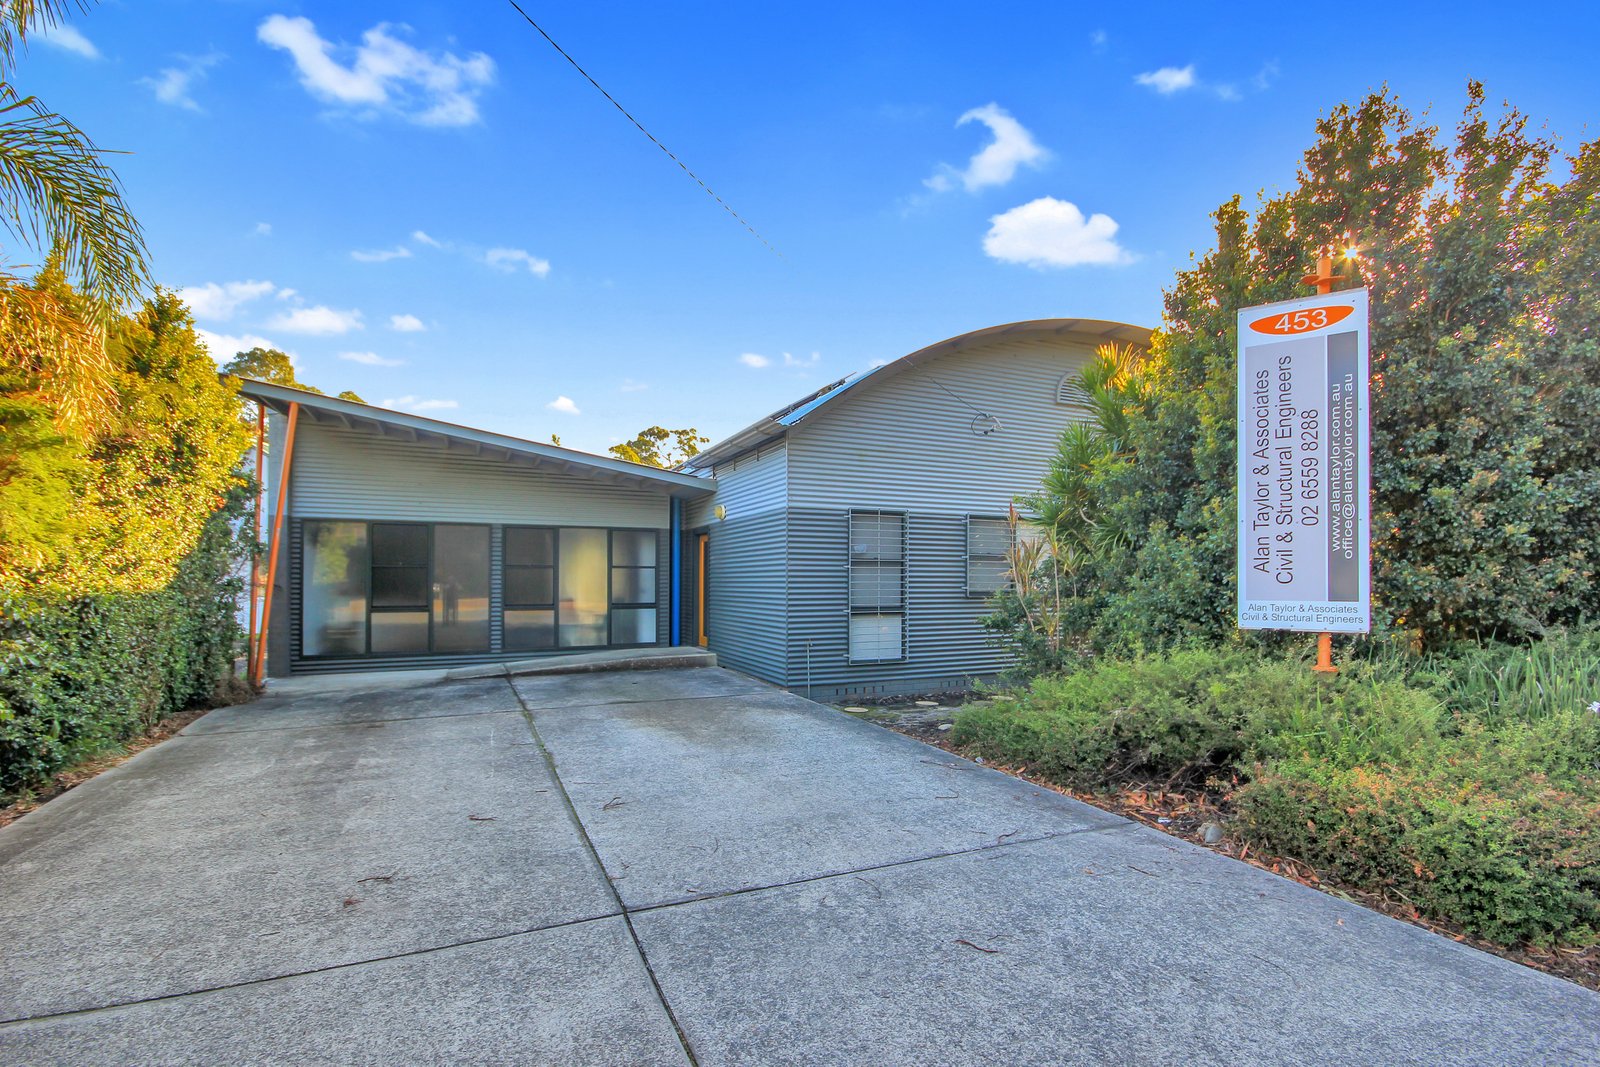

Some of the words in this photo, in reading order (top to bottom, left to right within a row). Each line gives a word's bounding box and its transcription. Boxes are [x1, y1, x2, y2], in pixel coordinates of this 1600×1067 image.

[1275, 309, 1328, 332] 453
[1252, 369, 1270, 460] Associates
[1275, 355, 1296, 440] Engineers
[1300, 409, 1319, 451] 8288
[1252, 464, 1270, 476] &
[1275, 446, 1293, 526] Structural
[1301, 457, 1319, 500] 6559
[1330, 383, 1343, 552] www.alantaylor.com.au
[1342, 373, 1356, 559] office@alantaylor.com.au
[1253, 481, 1274, 531] Taylor
[1301, 505, 1319, 526] 02
[1253, 536, 1270, 574] Alan
[1275, 531, 1293, 543] &
[1275, 549, 1294, 585] Civil
[1241, 612, 1260, 621] Civil
[1262, 613, 1269, 621] &
[1271, 613, 1313, 622] Structural
[1316, 613, 1364, 625] Engineers
[1248, 603, 1267, 612] Alan
[1270, 603, 1296, 614] Taylor
[1298, 604, 1305, 613] &
[1307, 604, 1359, 614] Associates
